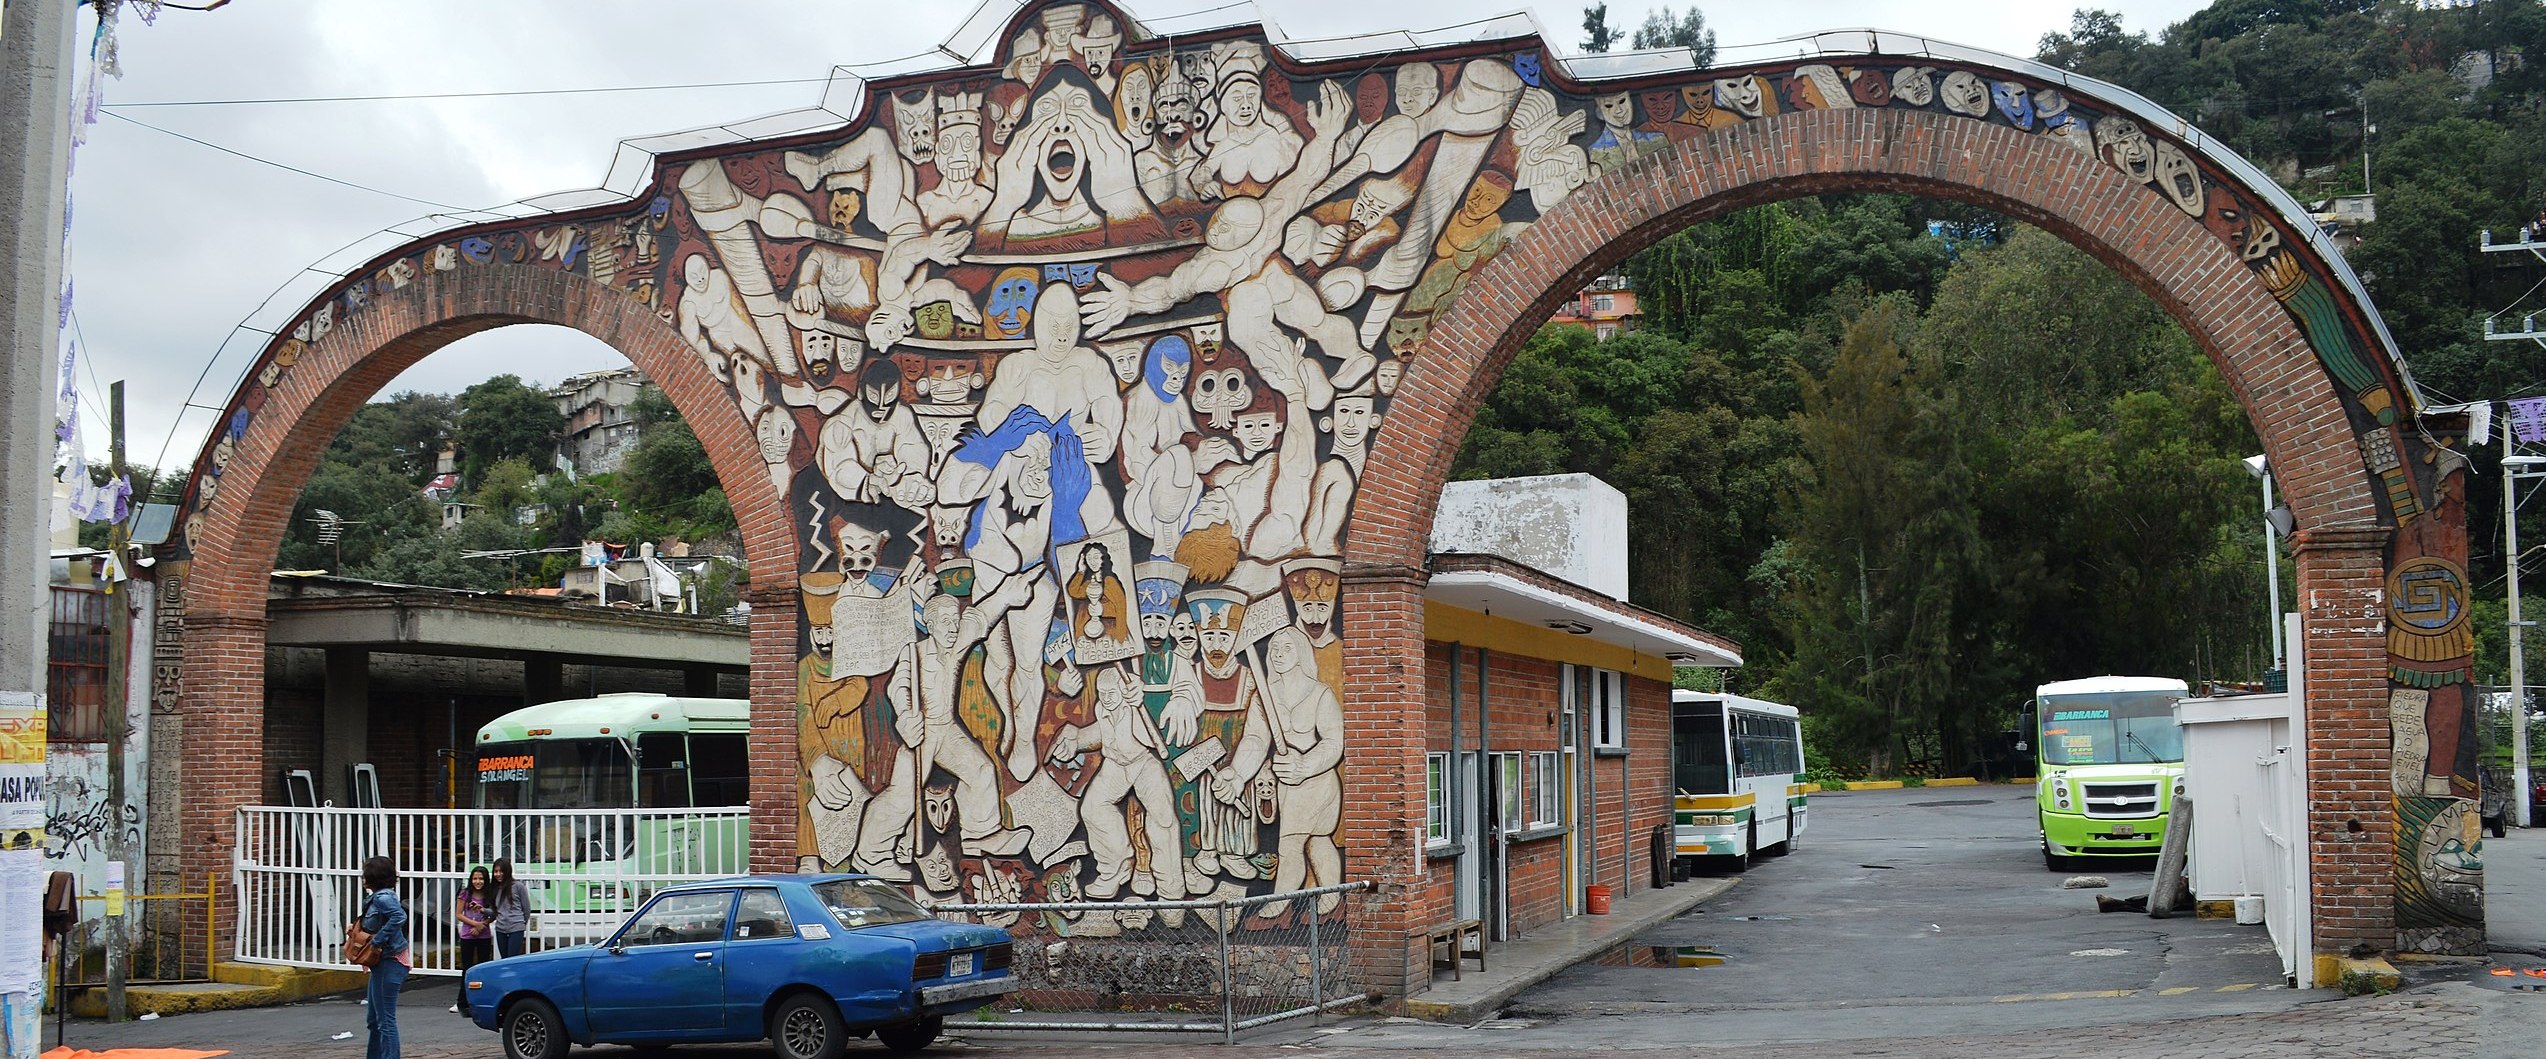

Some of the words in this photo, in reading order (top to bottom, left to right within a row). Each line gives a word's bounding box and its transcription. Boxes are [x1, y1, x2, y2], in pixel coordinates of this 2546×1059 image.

[1081, 646, 1136, 661] Magdalena
[2393, 690, 2427, 702] PIEDRA
[2394, 700, 2416, 713] QUE
[2392, 713, 2421, 726] BEBE
[2398, 726, 2426, 737] AGUA
[2395, 746, 2427, 763] PIEDRA
[0, 776, 22, 803] ASA
